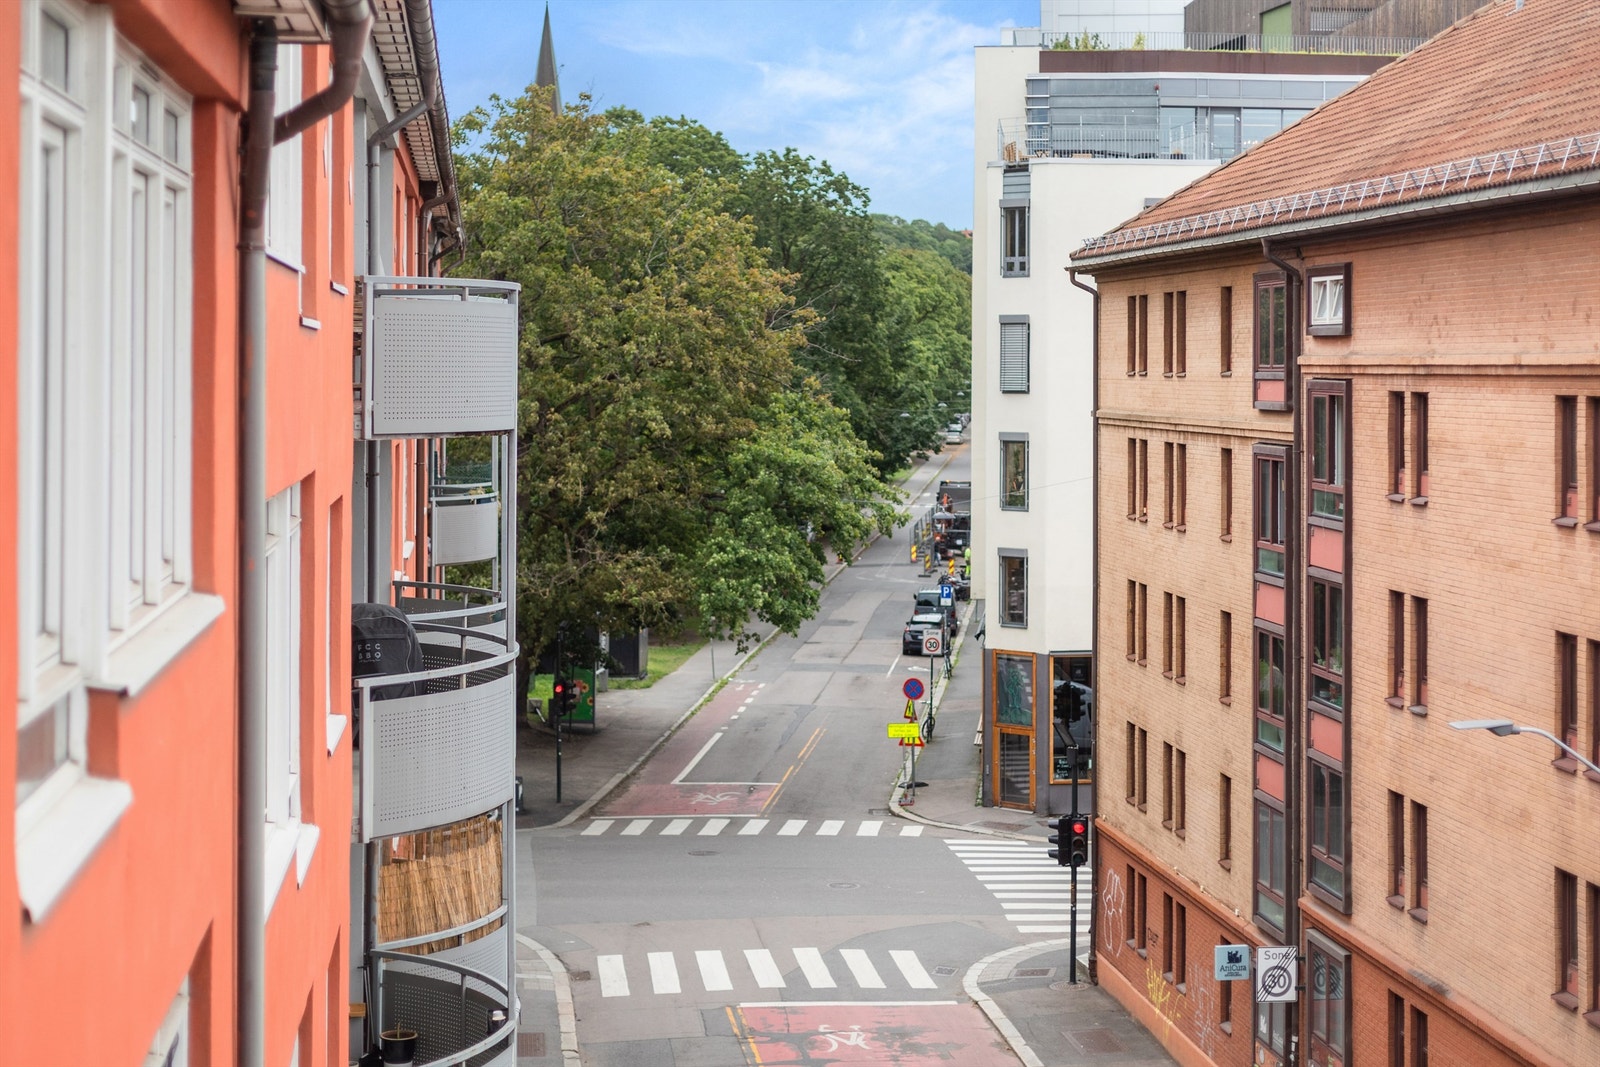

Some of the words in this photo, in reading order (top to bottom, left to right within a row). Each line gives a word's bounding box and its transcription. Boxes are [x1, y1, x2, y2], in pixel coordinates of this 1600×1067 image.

[928, 641, 938, 649] 30
[1264, 950, 1290, 961] Sone
[1219, 964, 1247, 972] AniCura
